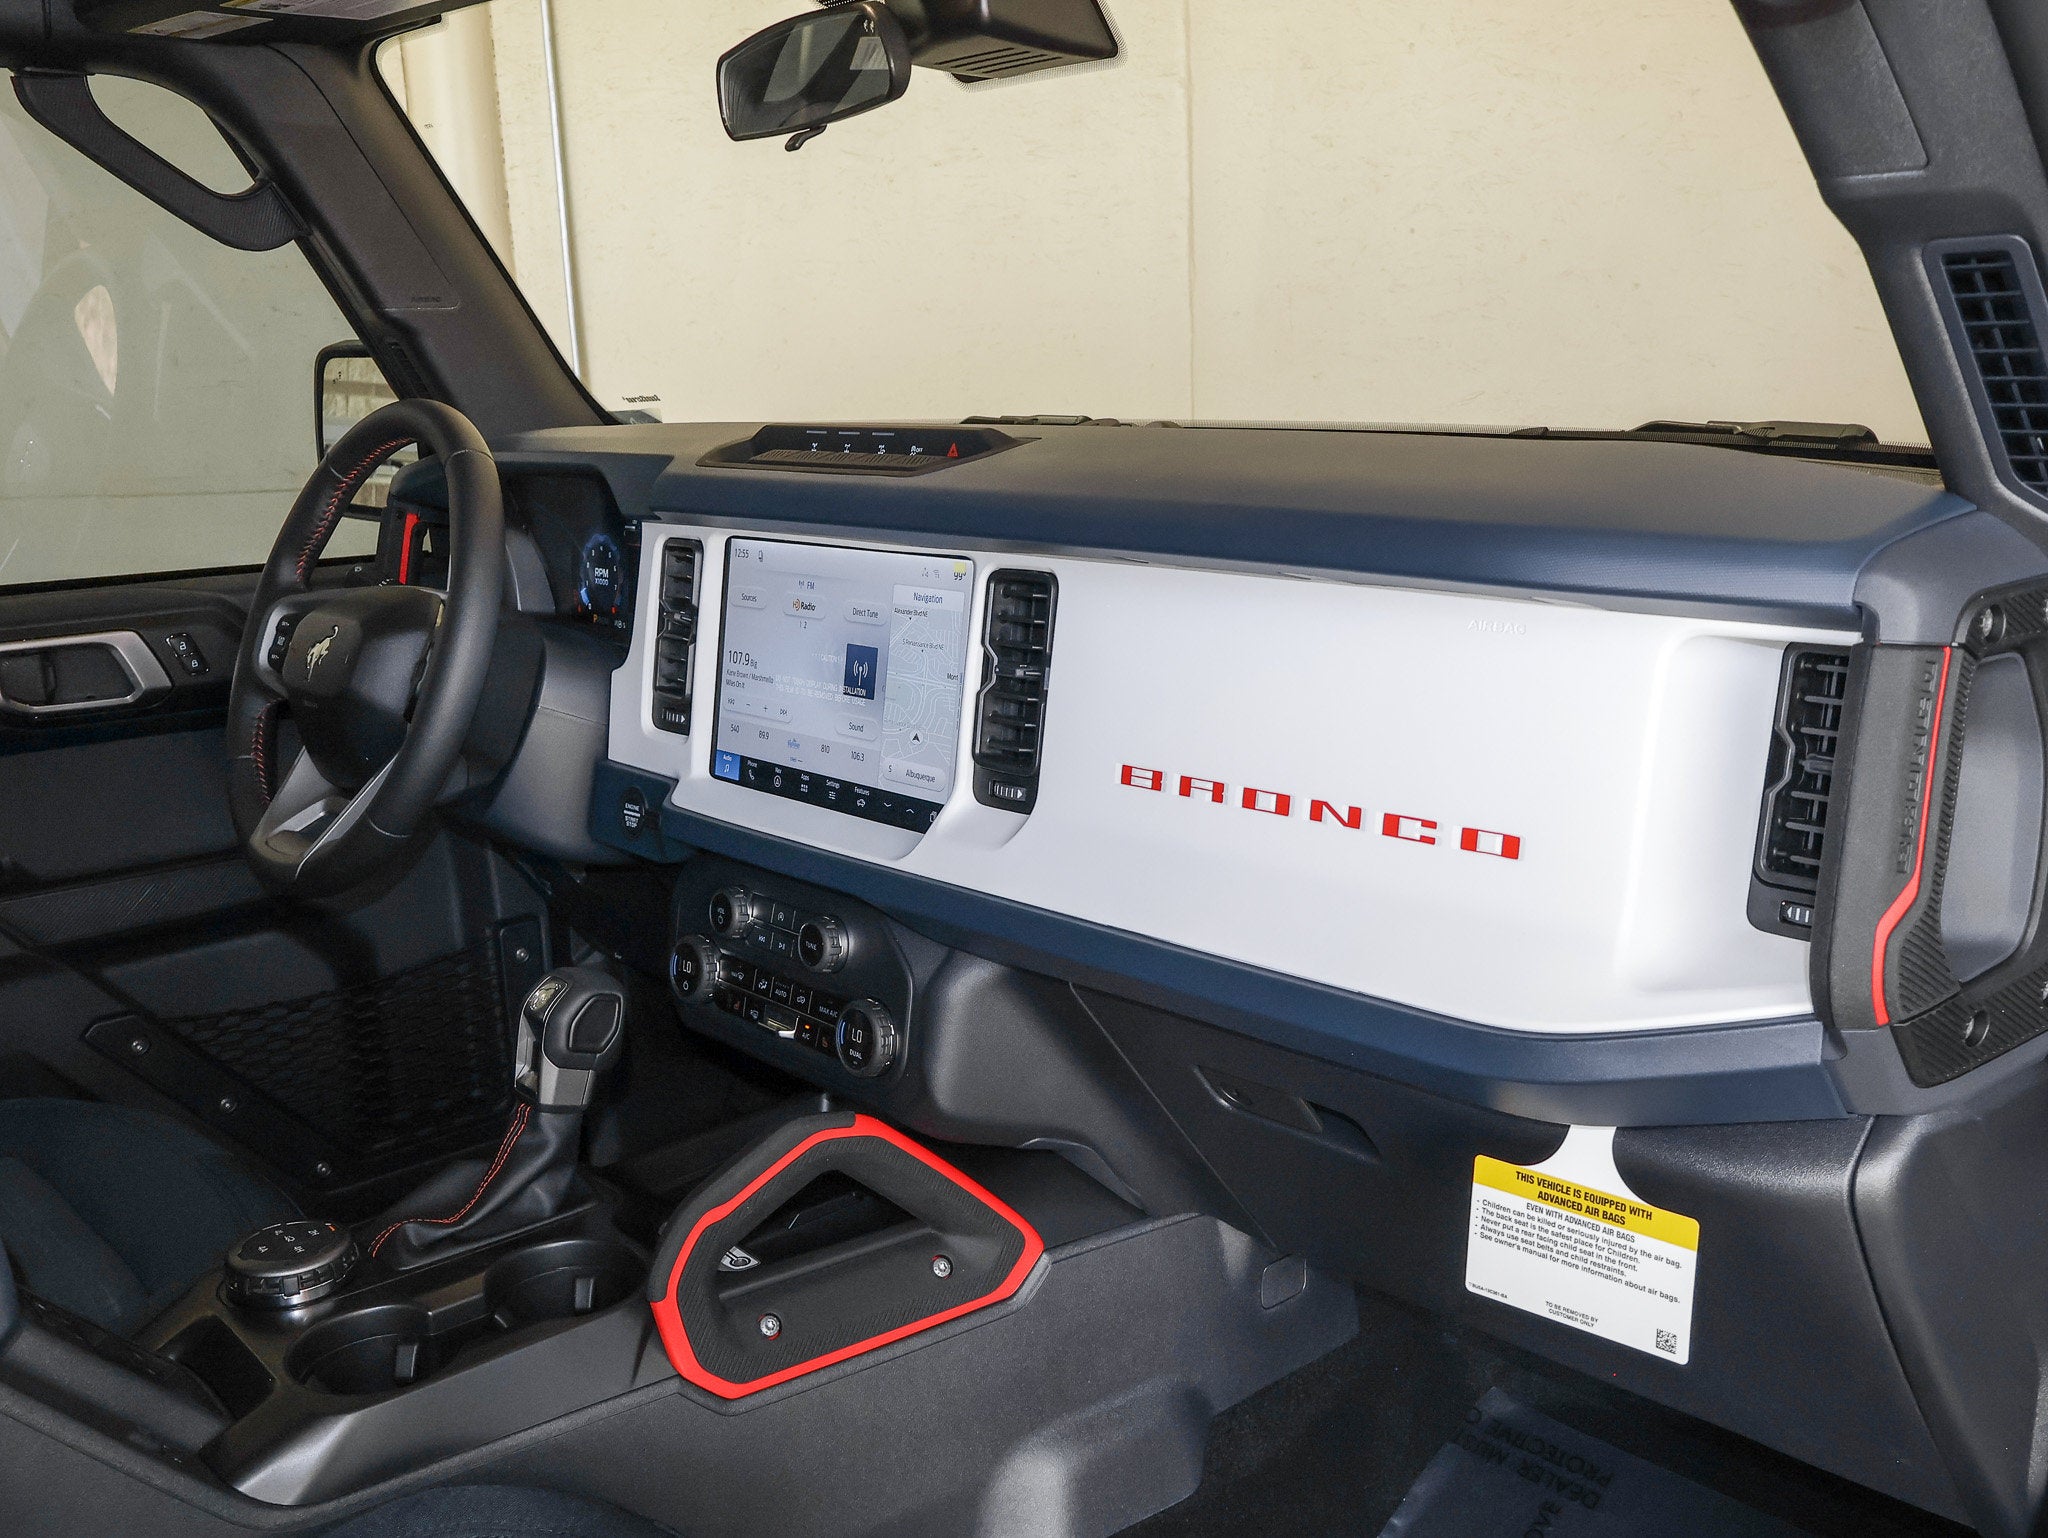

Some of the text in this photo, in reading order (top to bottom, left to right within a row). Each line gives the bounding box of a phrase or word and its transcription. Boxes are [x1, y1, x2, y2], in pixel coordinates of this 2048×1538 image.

[734, 548, 750, 559] 12:55
[594, 567, 609, 578] RPM
[806, 581, 815, 590] FM
[741, 592, 757, 602] Sources
[913, 592, 943, 605] Navigation
[852, 607, 879, 619] Direct Tune
[728, 650, 750, 666] 107.9
[730, 724, 740, 733] 540
[848, 721, 864, 732] Sound
[758, 730, 769, 740] 89.9
[905, 769, 936, 783] Albuquerque
[854, 786, 870, 796] Features
[1120, 764, 1520, 860] BRONCO
[805, 941, 817, 951] TUNE
[682, 959, 692, 974] LO
[775, 988, 788, 998] AUTO
[851, 1028, 863, 1044] LO
[849, 1048, 863, 1060] DUAL
[1515, 1171, 1653, 1220] THIS VEHICLE IS EQUIPPED WITH
[1537, 1190, 1626, 1225] ADVANCED AIR BAGS
[1526, 1202, 1635, 1243] EVEN WITH ADVANCED AIR BAGS
[1482, 1199, 1511, 1214] Children
[1512, 1209, 1525, 1218] can
[1526, 1212, 1536, 1221] be
[1537, 1216, 1556, 1228] killed
[1566, 1226, 1600, 1242] seriously
[1601, 1236, 1627, 1251] injured
[1628, 1245, 1638, 1255] by
[1640, 1249, 1652, 1259] the
[1653, 1254, 1664, 1262] air
[1665, 1258, 1682, 1269] bag.
[1482, 1207, 1494, 1217] The
[1495, 1211, 1512, 1223] back
[1513, 1218, 1529, 1227] seat
[1538, 1225, 1549, 1234] the
[1550, 1229, 1572, 1242] safest
[1573, 1237, 1593, 1249] place
[1595, 1243, 1606, 1252] for
[1607, 1247, 1640, 1264] Children.
[1480, 1223, 1505, 1237] Always
[1506, 1232, 1519, 1241] use
[1520, 1236, 1535, 1246] seat
[1536, 1241, 1554, 1253] belts
[1555, 1247, 1569, 1258] and
[1570, 1252, 1588, 1264] child
[1481, 1215, 1501, 1227] Never
[1502, 1223, 1514, 1232] put
[1521, 1229, 1535, 1238] rear
[1536, 1232, 1558, 1246] facing
[1559, 1240, 1577, 1252] child
[1579, 1247, 1595, 1257] seat
[1595, 1252, 1603, 1260] in
[1604, 1255, 1617, 1264] the
[1618, 1260, 1638, 1272] front.
[1480, 1231, 1680, 1303] See owner's manual for more information about air bags.
[1545, 1300, 1599, 1323] TO BE REMOVED BY
[1548, 1308, 1595, 1328] CUSTOMER ONLY
